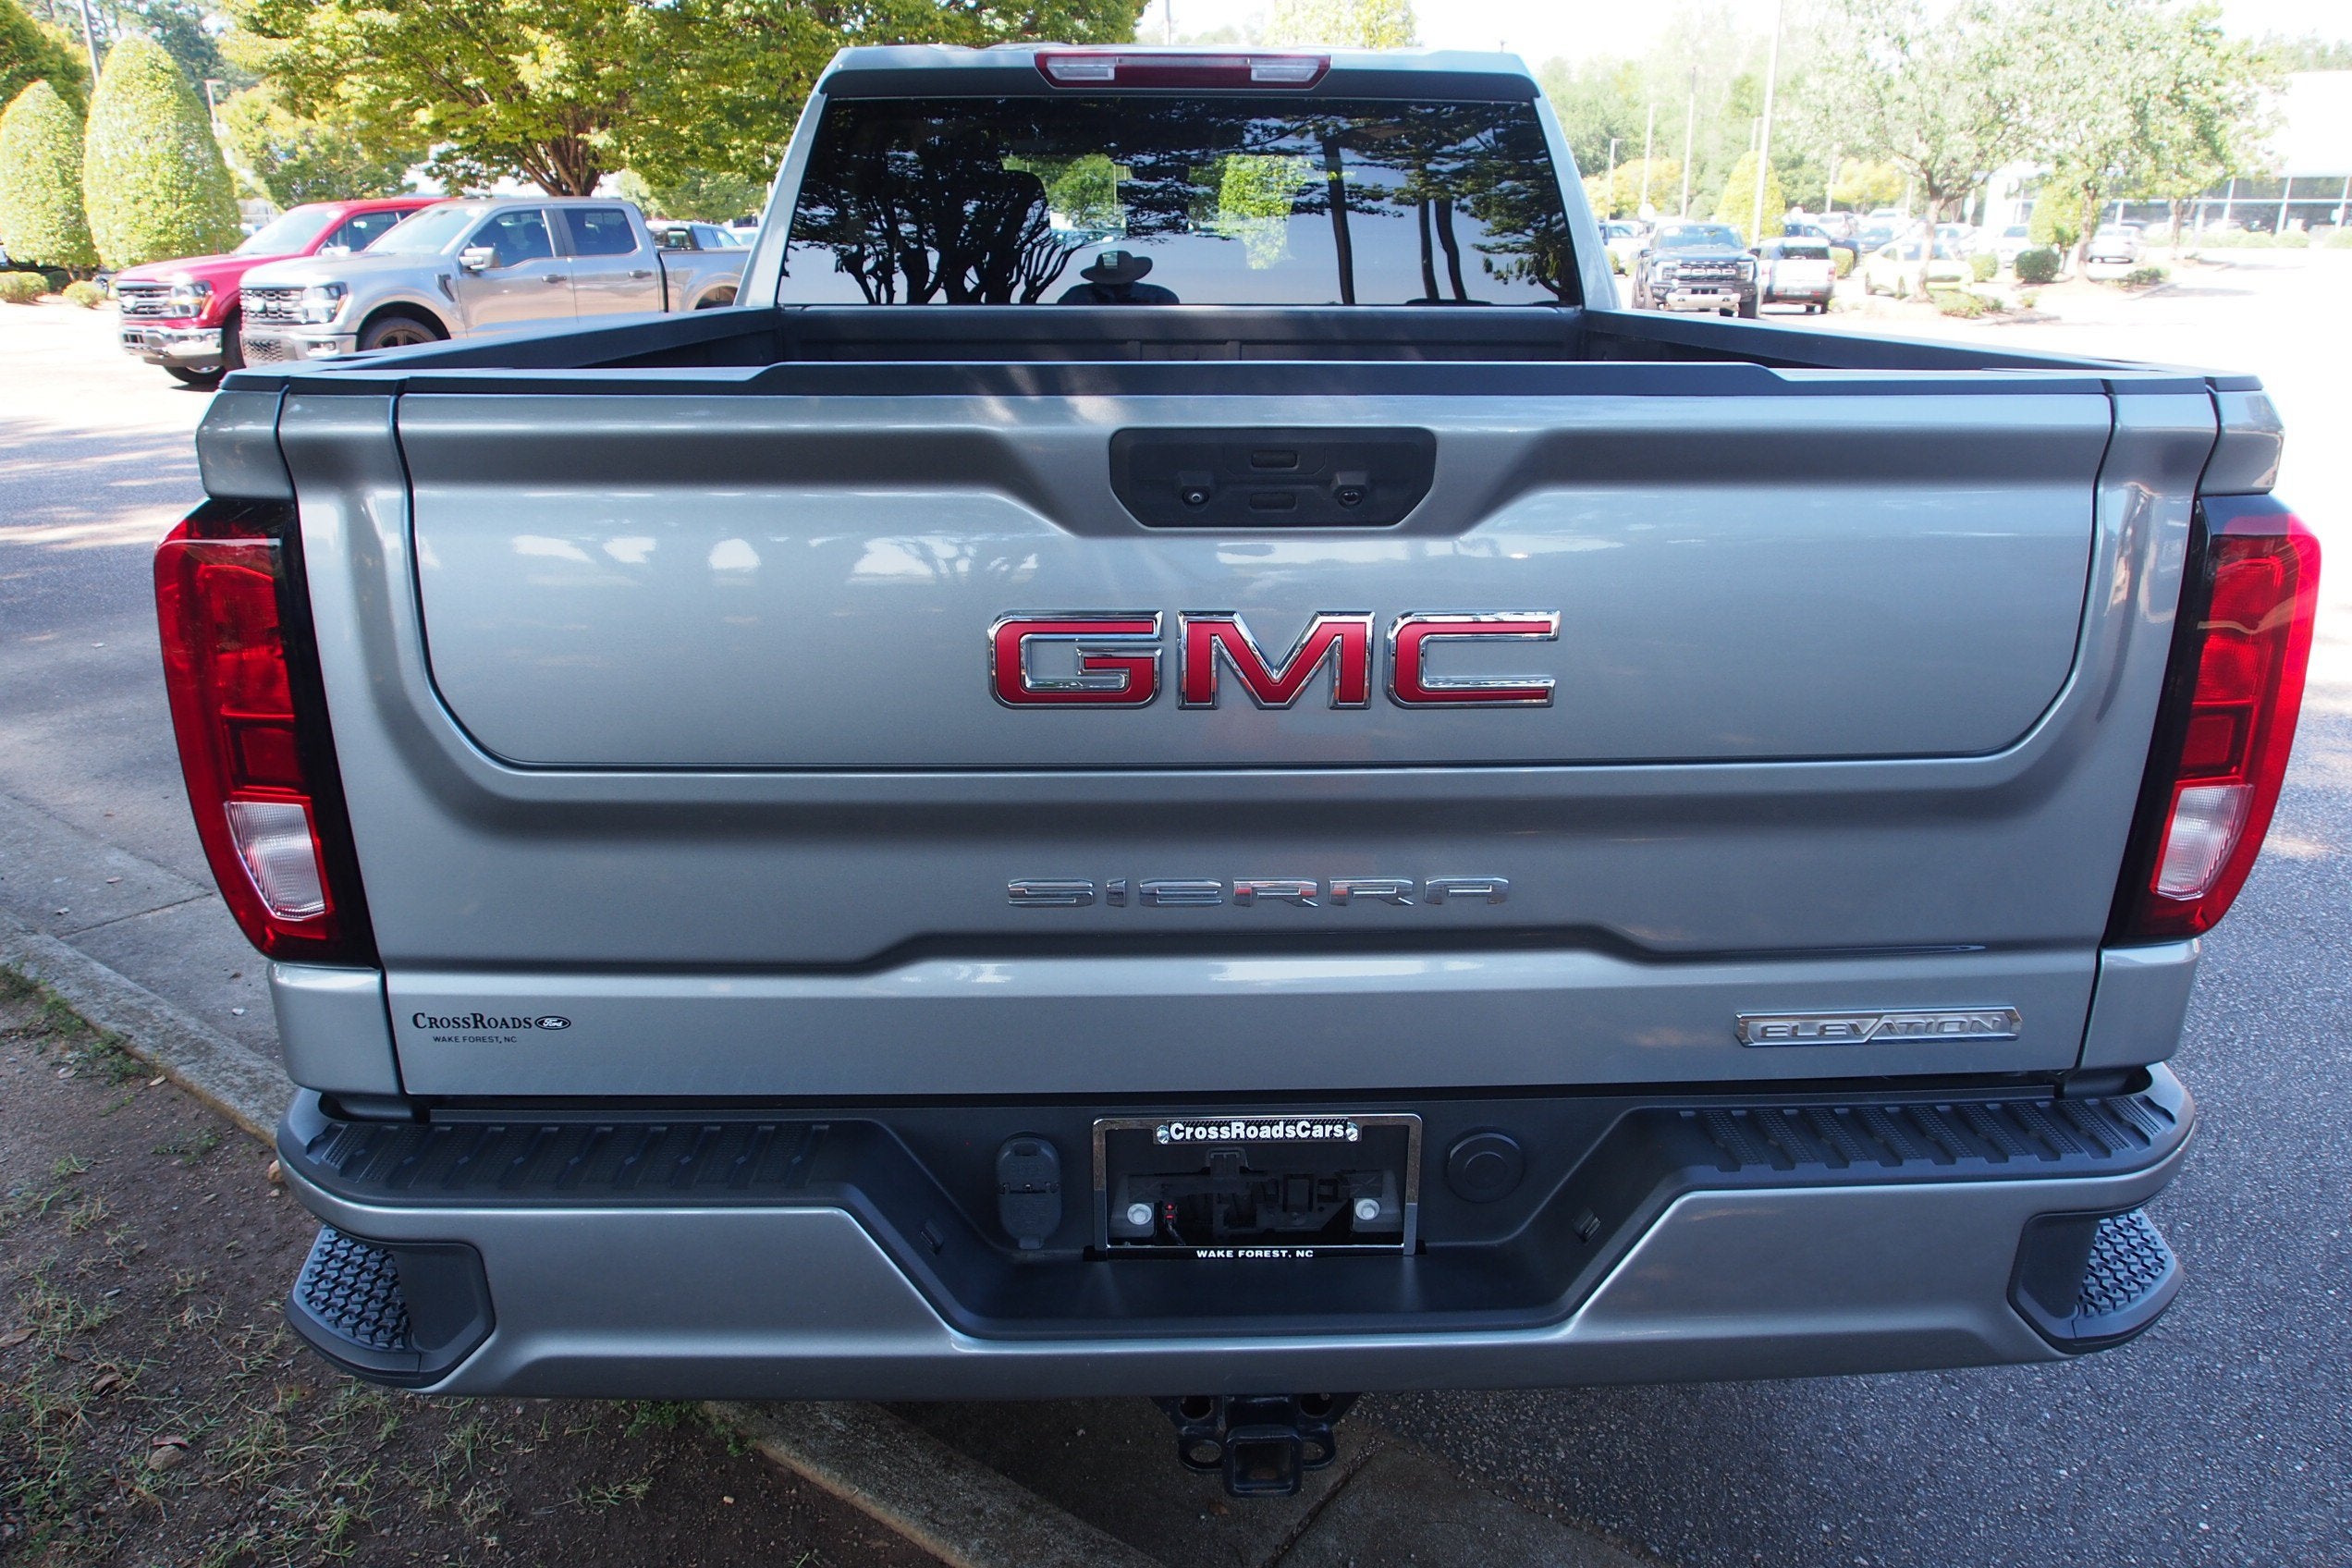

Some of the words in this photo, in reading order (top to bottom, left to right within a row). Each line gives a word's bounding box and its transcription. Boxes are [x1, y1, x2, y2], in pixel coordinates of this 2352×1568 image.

[987, 609, 1561, 710] GMC
[1008, 876, 1510, 908] SIERRA
[1760, 1016, 2002, 1038] ELEVATION
[463, 1035, 502, 1044] FOREST,
[1170, 1121, 1344, 1139] CrossRoadsCars
[1196, 1250, 1234, 1258] WAKE
[1238, 1250, 1292, 1258] FOREST,
[1295, 1250, 1314, 1258] NC
